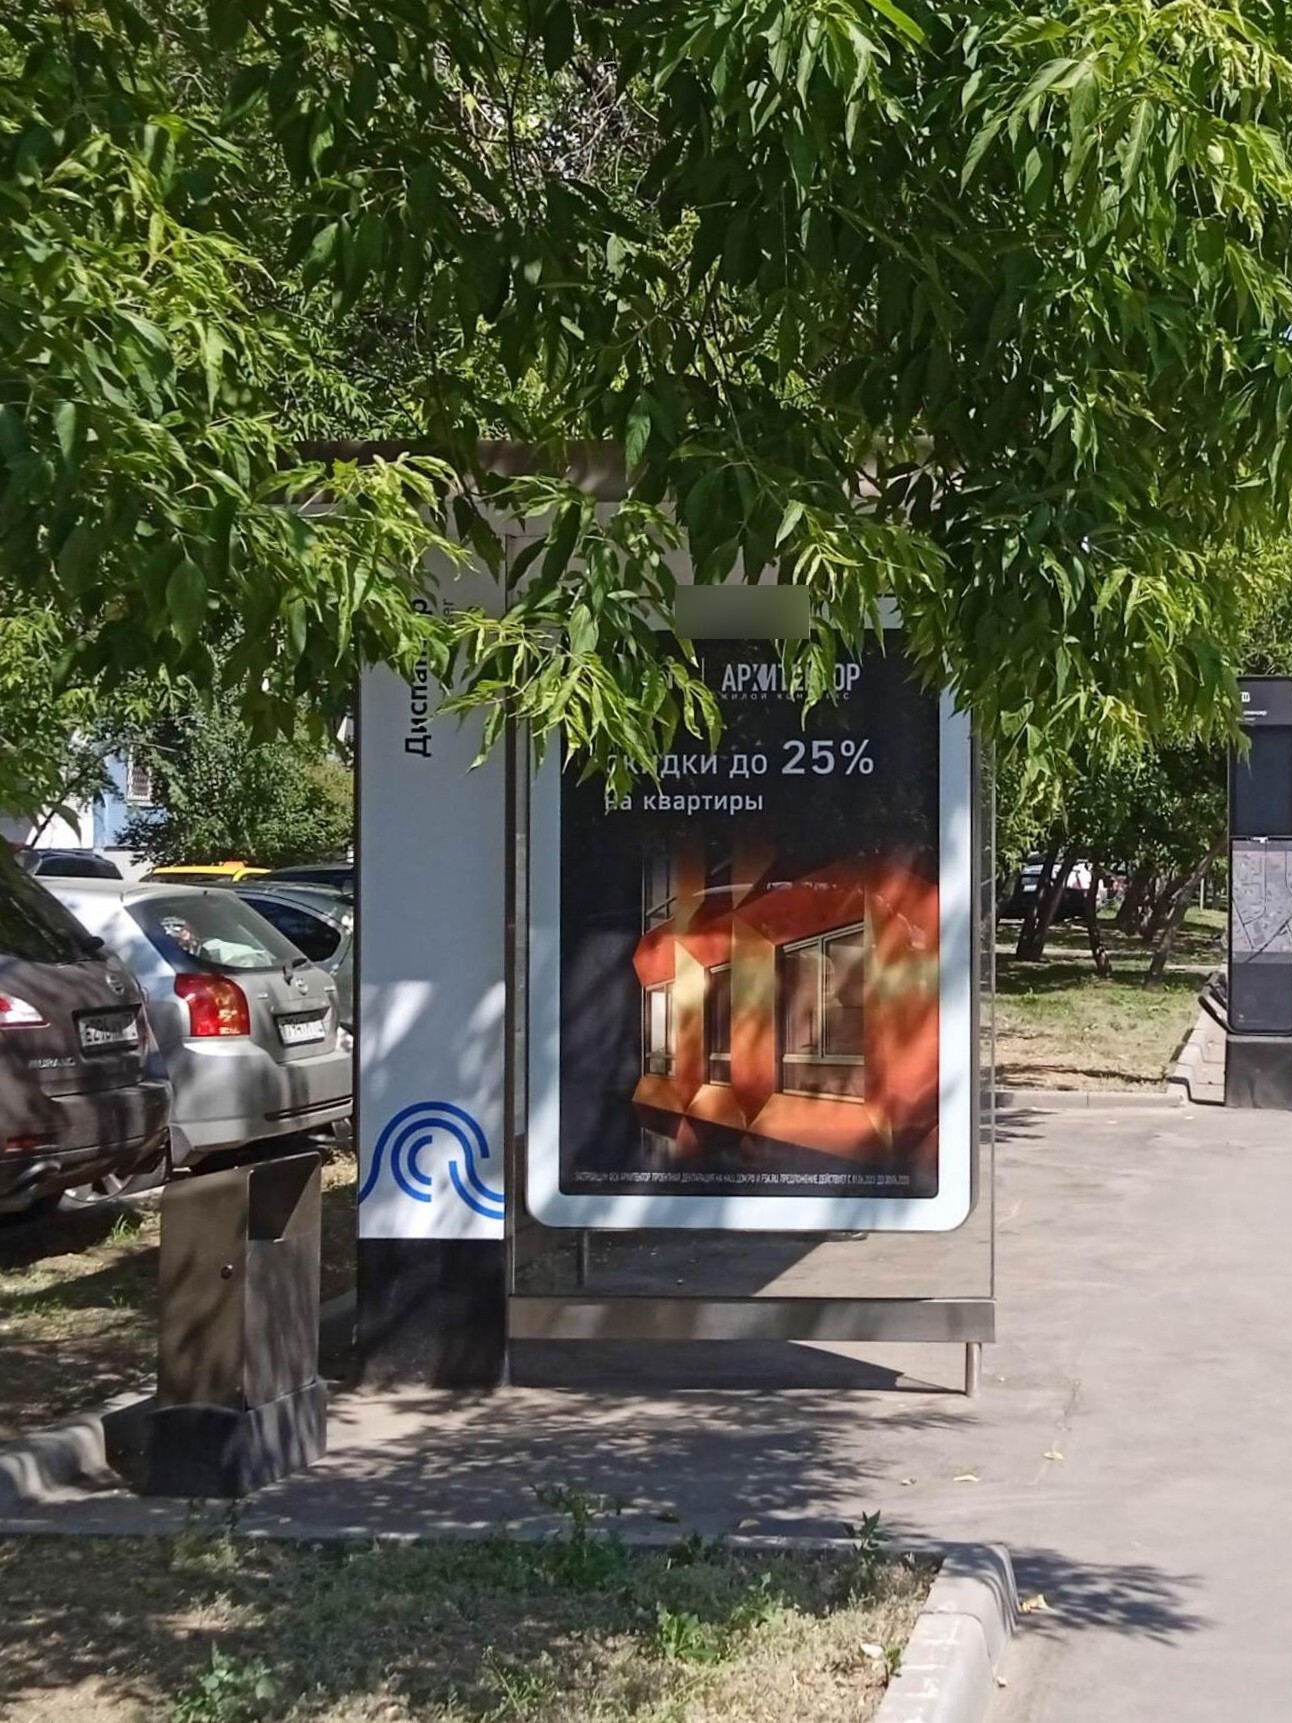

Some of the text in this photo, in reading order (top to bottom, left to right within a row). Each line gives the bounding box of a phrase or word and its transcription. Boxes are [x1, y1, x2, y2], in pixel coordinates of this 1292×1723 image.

[729, 754, 768, 779] до
[781, 739, 875, 775] 25%
[643, 794, 764, 816] квартиры
